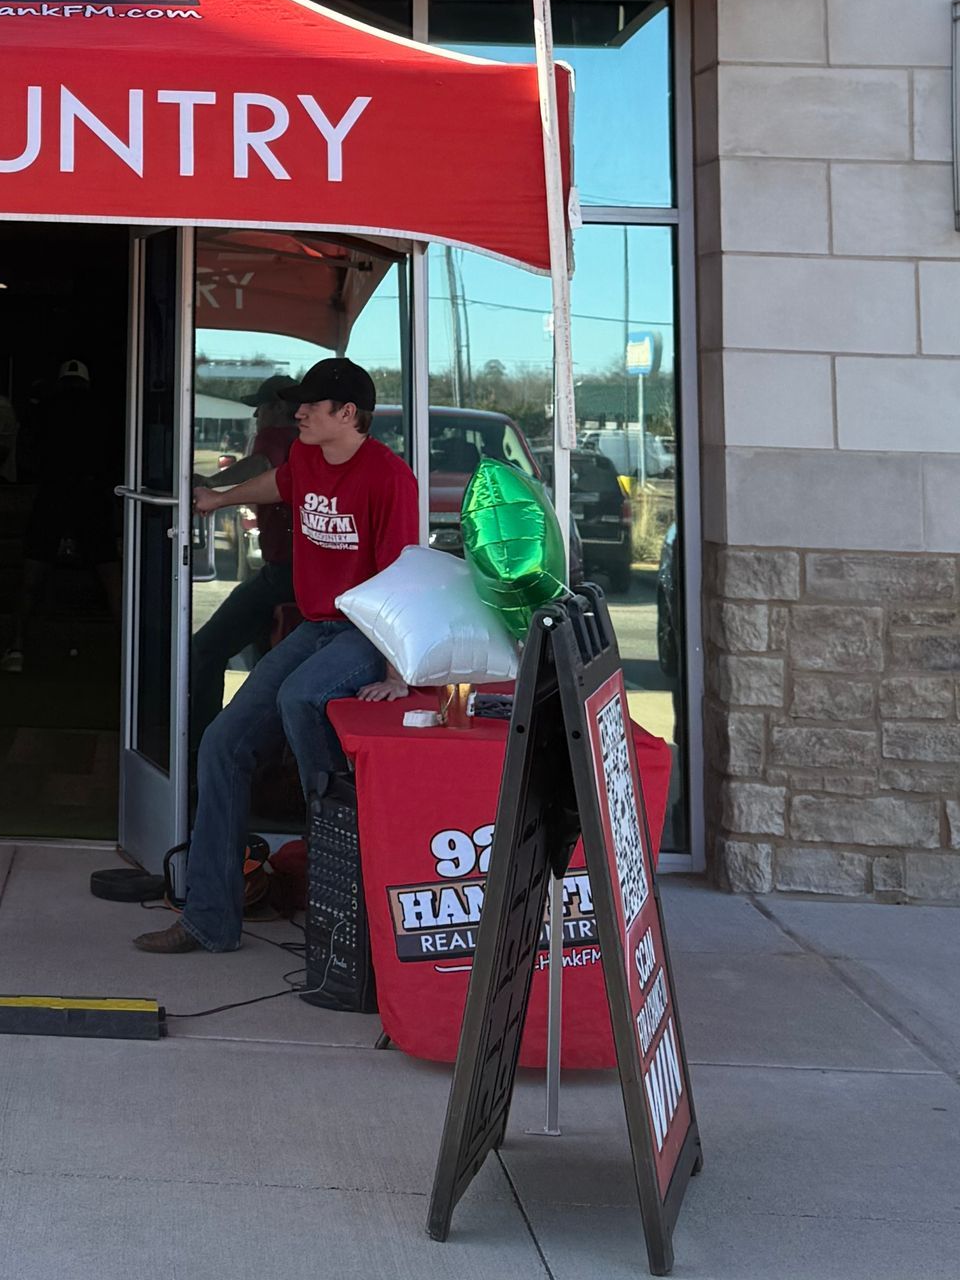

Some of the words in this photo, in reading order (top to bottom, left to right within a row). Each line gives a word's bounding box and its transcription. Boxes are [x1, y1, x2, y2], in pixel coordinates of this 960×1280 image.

[398, 884, 485, 929] HAN
[420, 930, 476, 952] REAL
[635, 926, 656, 991] SCAN
[644, 1017, 682, 1152] WIN
